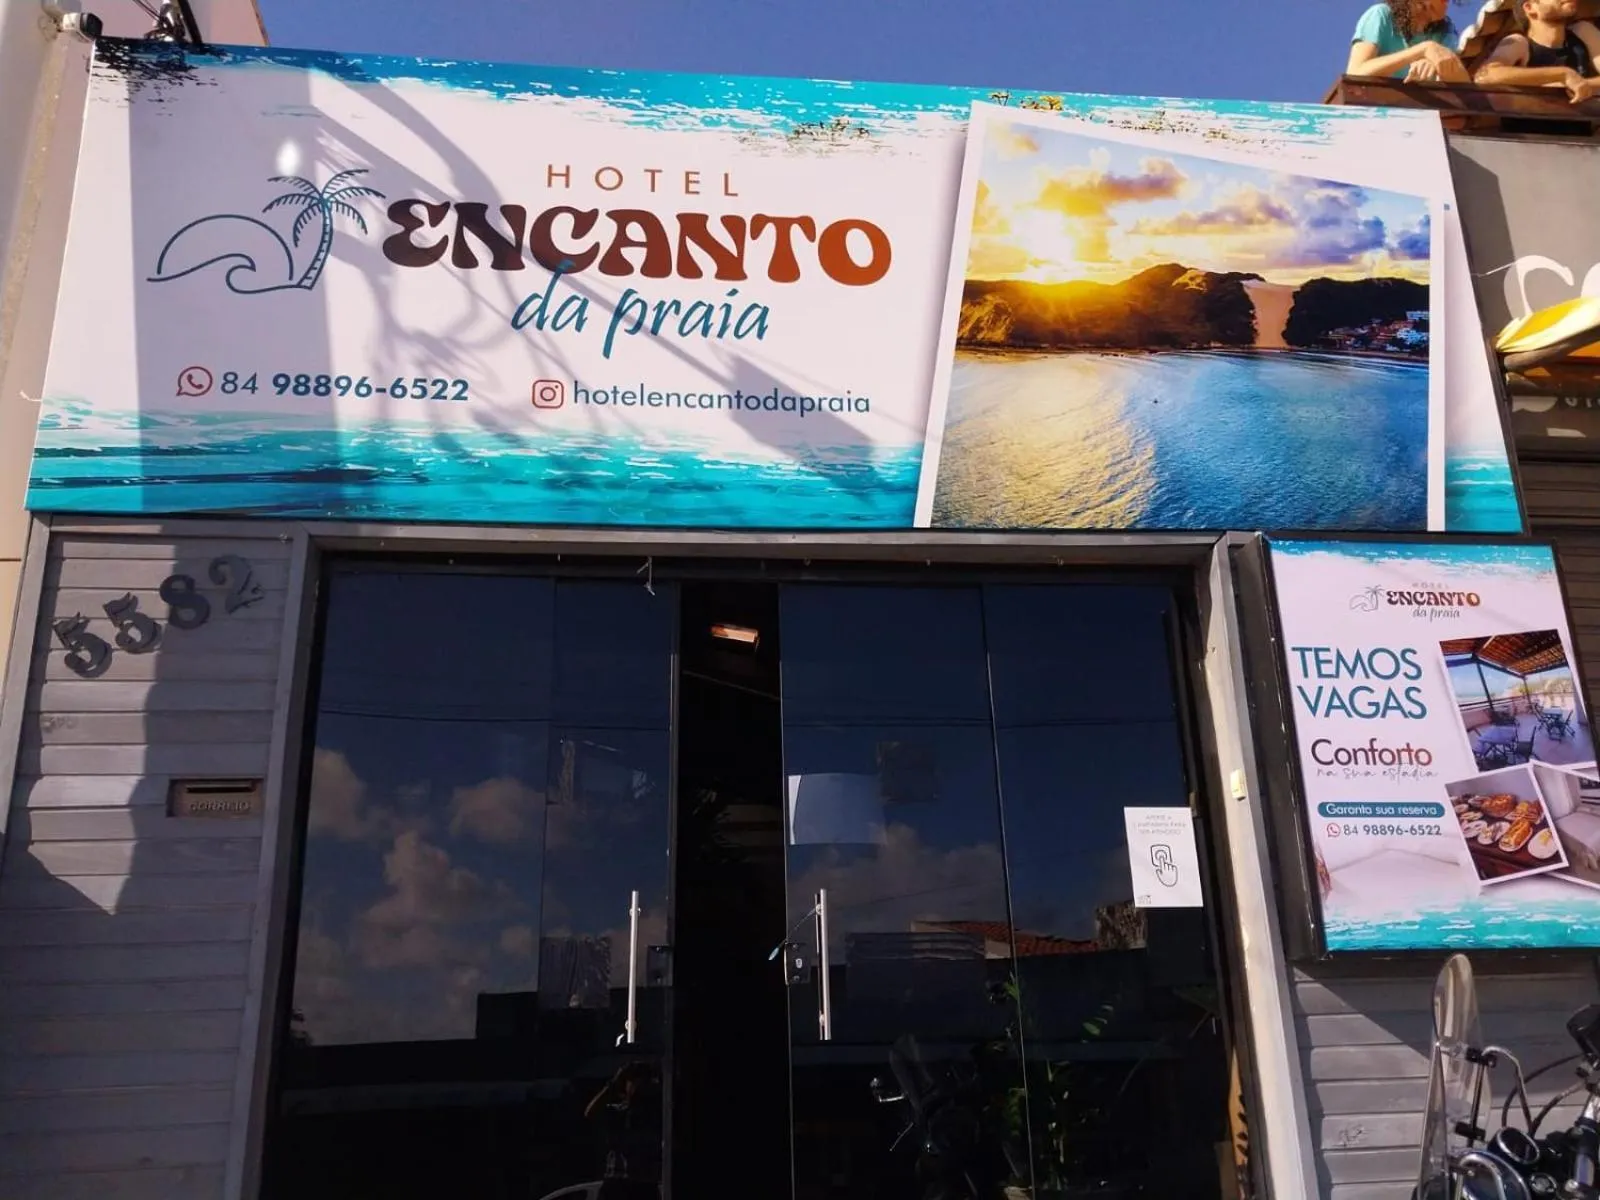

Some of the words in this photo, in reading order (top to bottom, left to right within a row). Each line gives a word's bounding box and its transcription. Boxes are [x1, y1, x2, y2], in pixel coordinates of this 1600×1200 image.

[546, 164, 739, 197] HOTEL
[382, 198, 892, 286] ENCANTO
[510, 259, 589, 333] da
[602, 288, 770, 359] praia
[220, 371, 259, 395] 84
[272, 373, 469, 401] 98896-6522
[573, 380, 870, 418] hotelencantodapraia
[1386, 590, 1481, 607] ENCANTO
[1430, 607, 1461, 622] praia
[52, 554, 265, 679] 5582
[1291, 647, 1423, 681] TEMOS
[1296, 685, 1427, 720] VAGAS
[1311, 738, 1433, 766] Conforto
[1326, 803, 1372, 815] Garanta
[1375, 806, 1395, 815] sua
[1398, 806, 1437, 815] reserva
[1343, 825, 1359, 836] 84
[1363, 824, 1442, 836] 98896-6522
